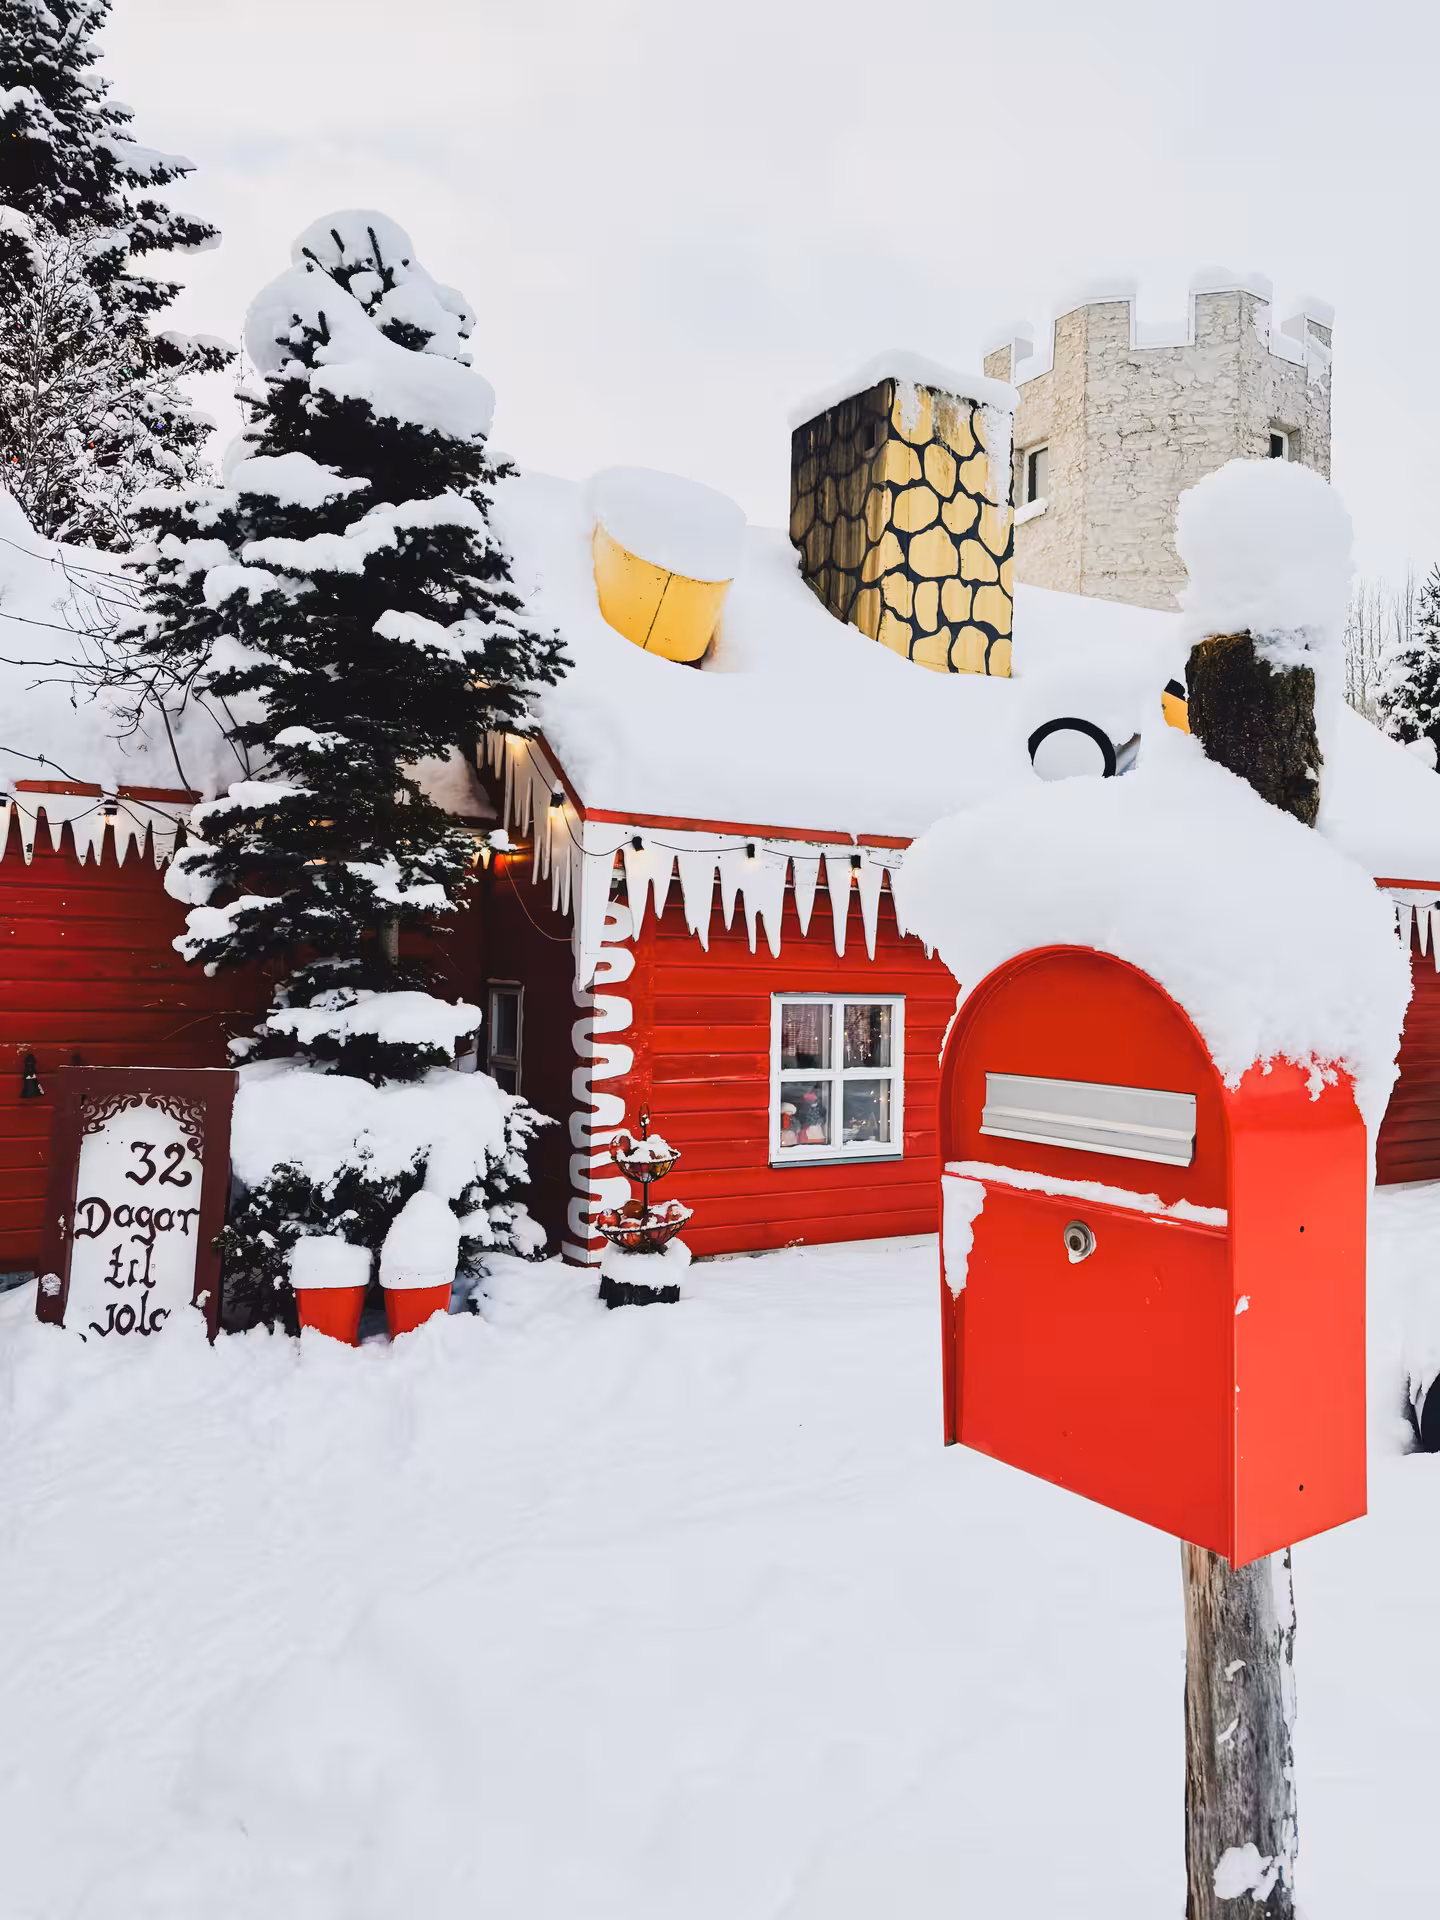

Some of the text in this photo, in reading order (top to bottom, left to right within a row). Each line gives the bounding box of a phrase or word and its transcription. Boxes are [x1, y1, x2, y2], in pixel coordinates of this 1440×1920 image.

[125, 1141, 193, 1188] 32
[74, 1196, 200, 1246] Dagar
[103, 1243, 157, 1289] til
